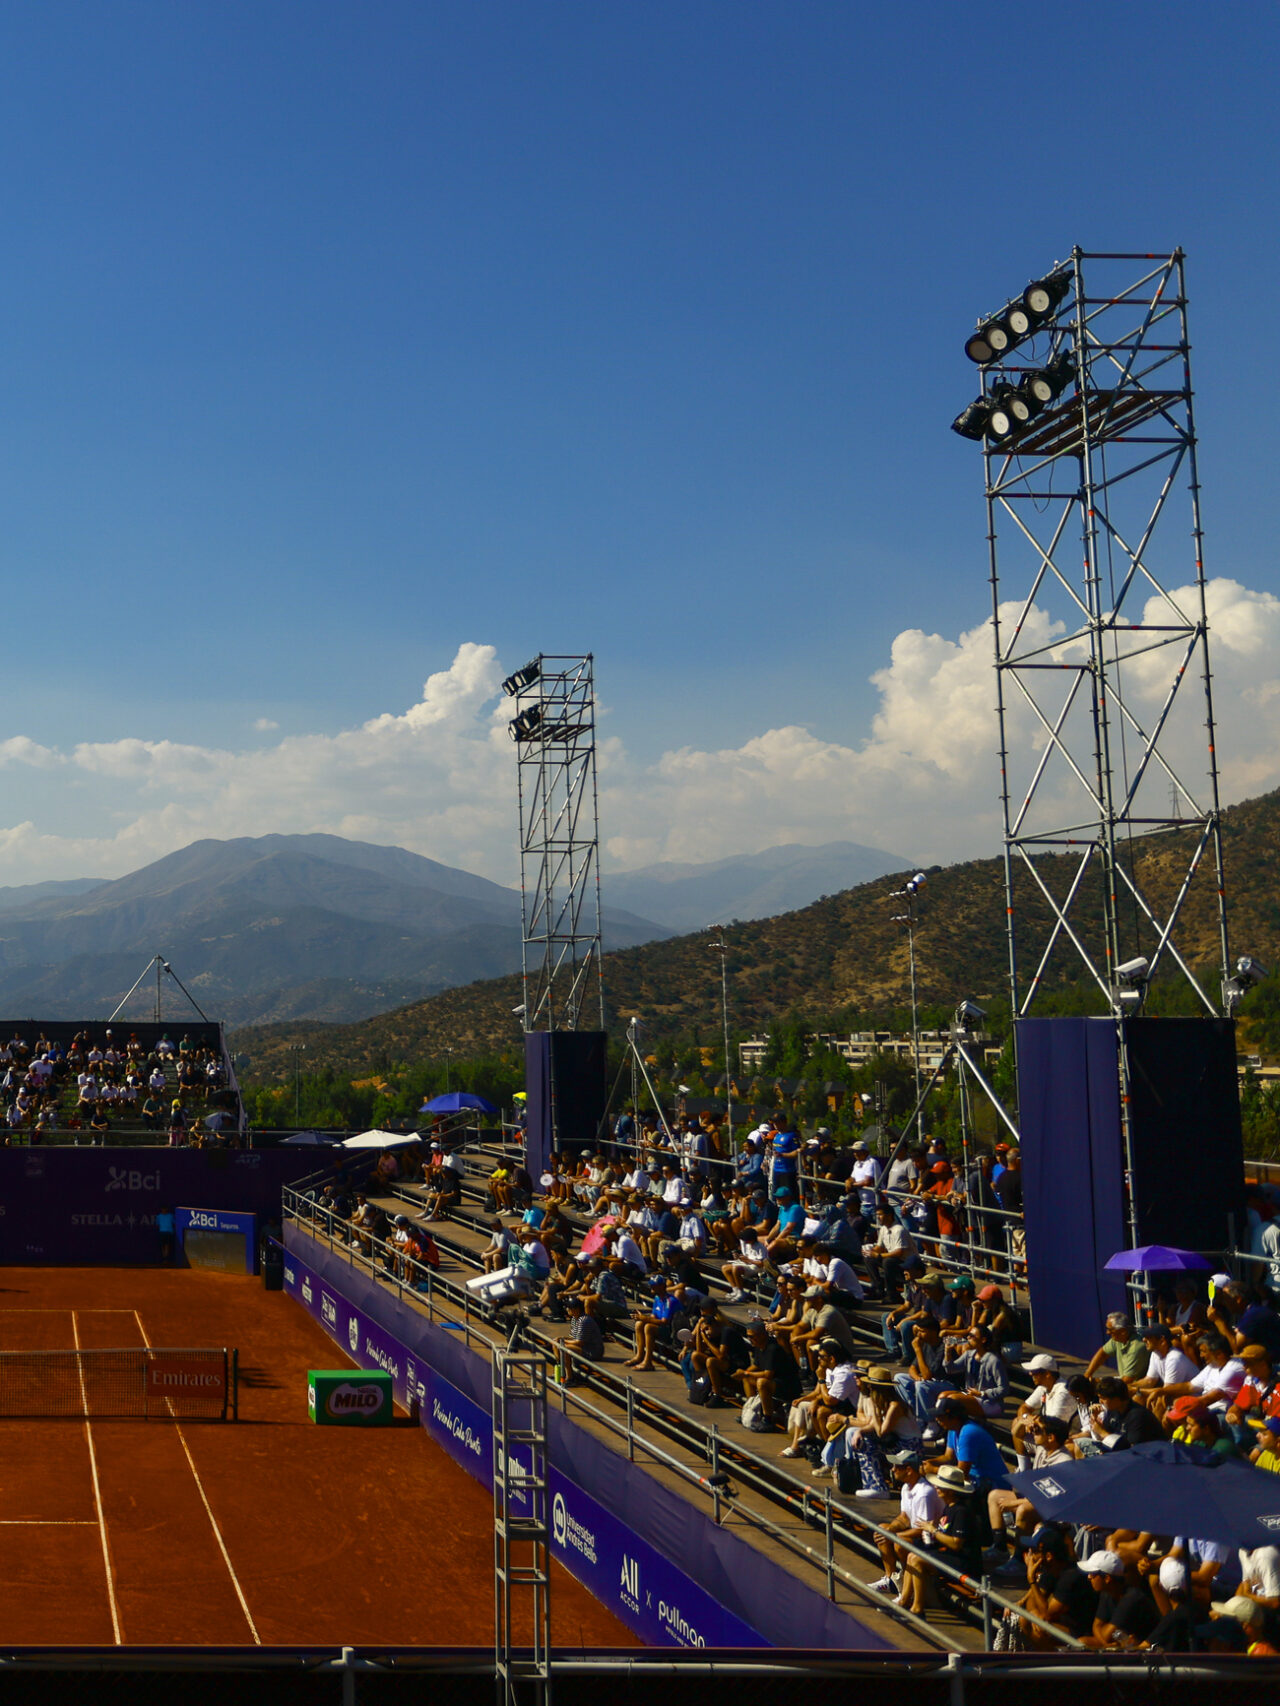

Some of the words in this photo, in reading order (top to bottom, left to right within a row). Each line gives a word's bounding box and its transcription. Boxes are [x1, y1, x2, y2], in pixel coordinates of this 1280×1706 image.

[129, 1169, 161, 1191] Bci
[71, 1213, 123, 1226] STELLA
[200, 1213, 218, 1228] Bci
[152, 1369, 221, 1387] Emirates
[333, 1391, 379, 1409] MILO
[620, 1590, 640, 1615] ACCOR
[658, 1600, 705, 1648] pullman
